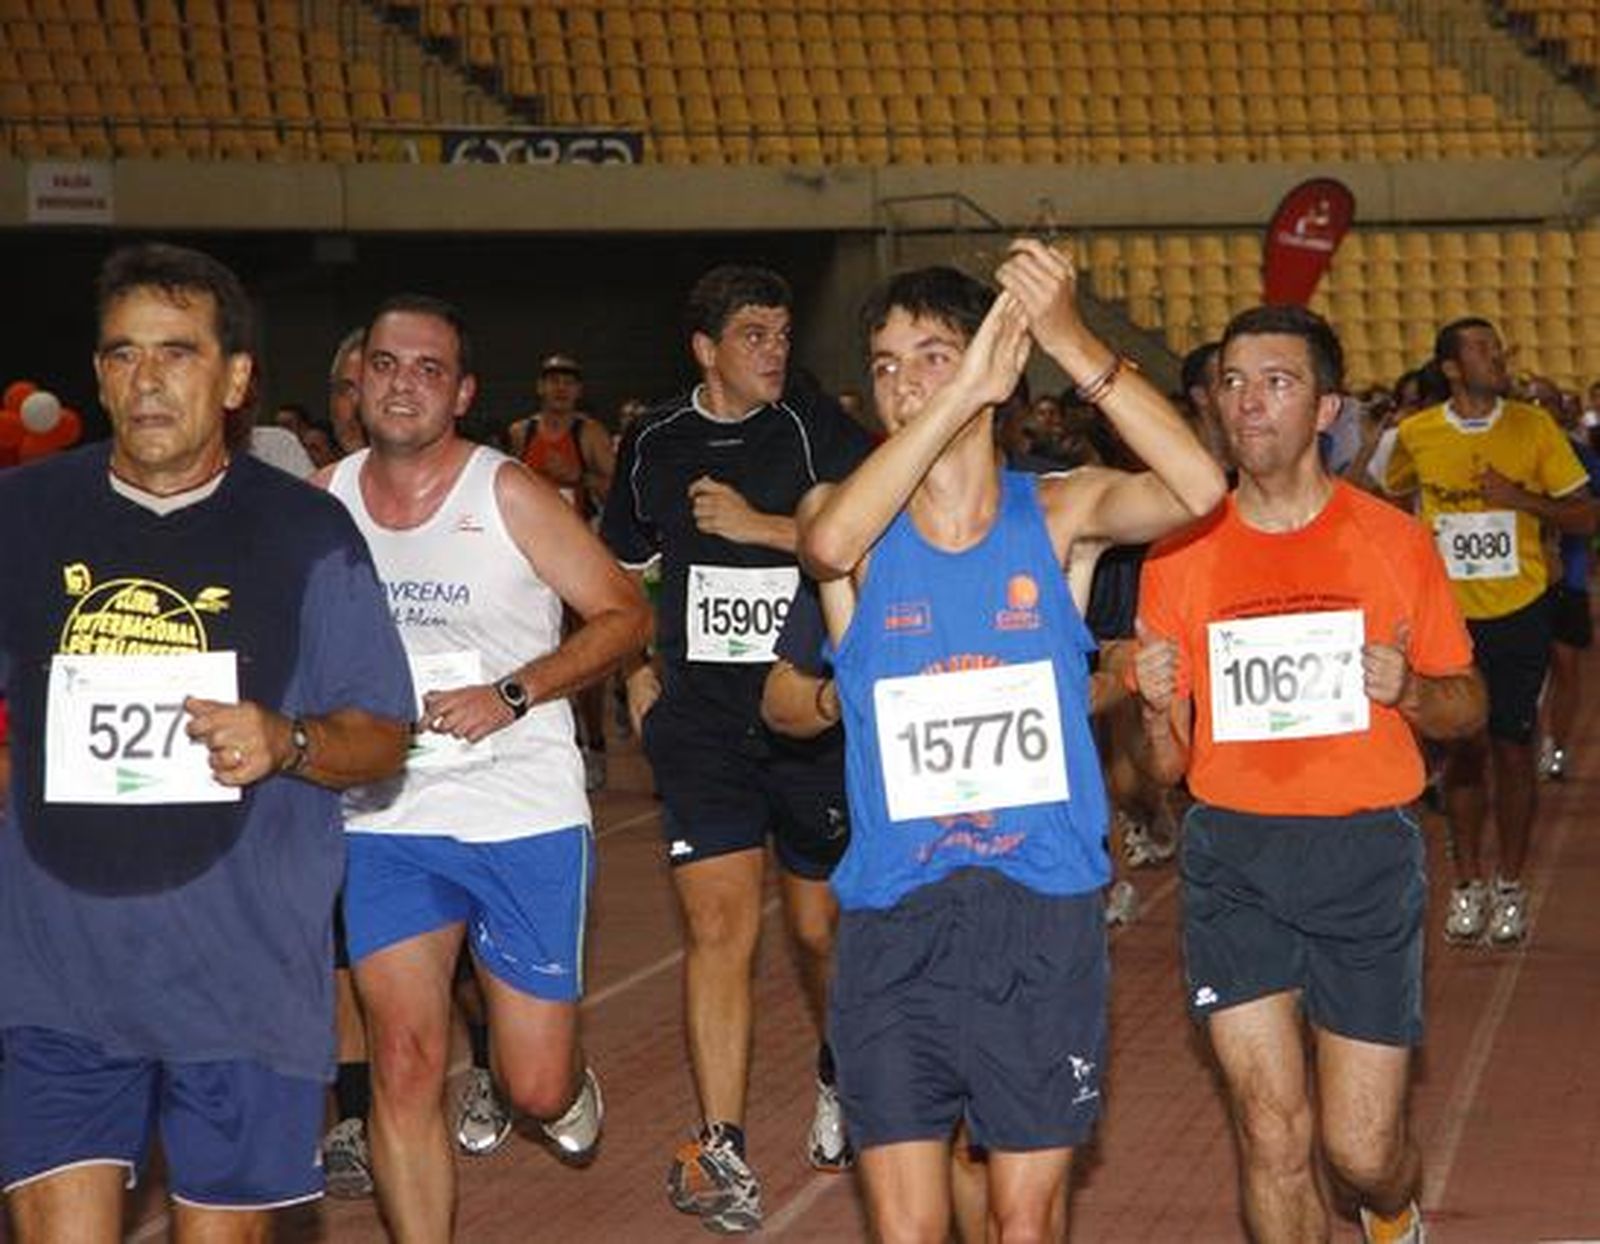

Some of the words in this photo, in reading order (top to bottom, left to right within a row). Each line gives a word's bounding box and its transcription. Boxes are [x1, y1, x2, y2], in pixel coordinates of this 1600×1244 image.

[698, 597, 792, 636] 15909
[1224, 652, 1353, 707] 10627
[88, 703, 184, 761] 527
[897, 707, 1049, 775] 15776
